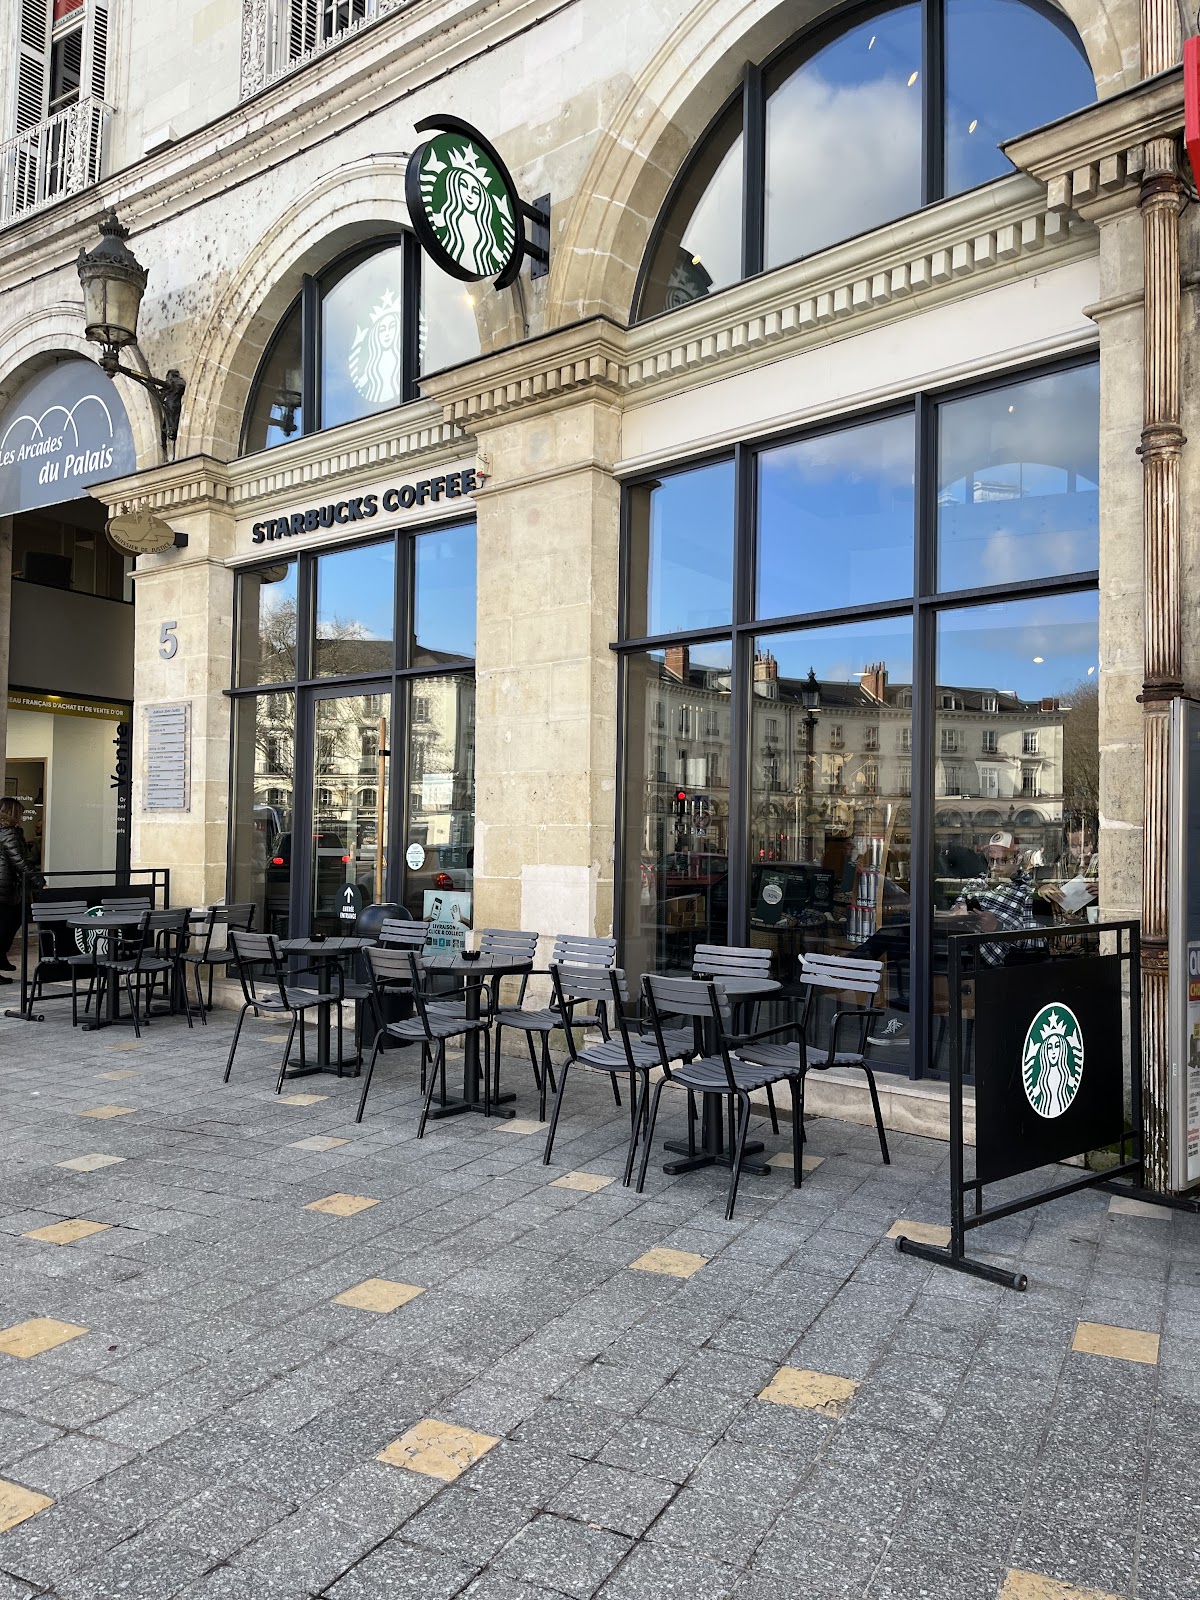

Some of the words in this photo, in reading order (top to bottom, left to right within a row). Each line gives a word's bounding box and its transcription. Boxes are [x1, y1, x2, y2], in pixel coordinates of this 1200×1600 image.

[0, 449, 16, 467] Les
[17, 436, 63, 462] Arcades
[39, 461, 60, 485] du
[63, 443, 114, 479] Palais
[252, 494, 378, 544] STARBUCKS
[382, 468, 476, 513] COFFEE
[159, 621, 178, 660] 5
[22, 698, 52, 708] FRANÇAIS
[52, 702, 77, 710] D'ACHAT
[110, 724, 128, 789] Vente
